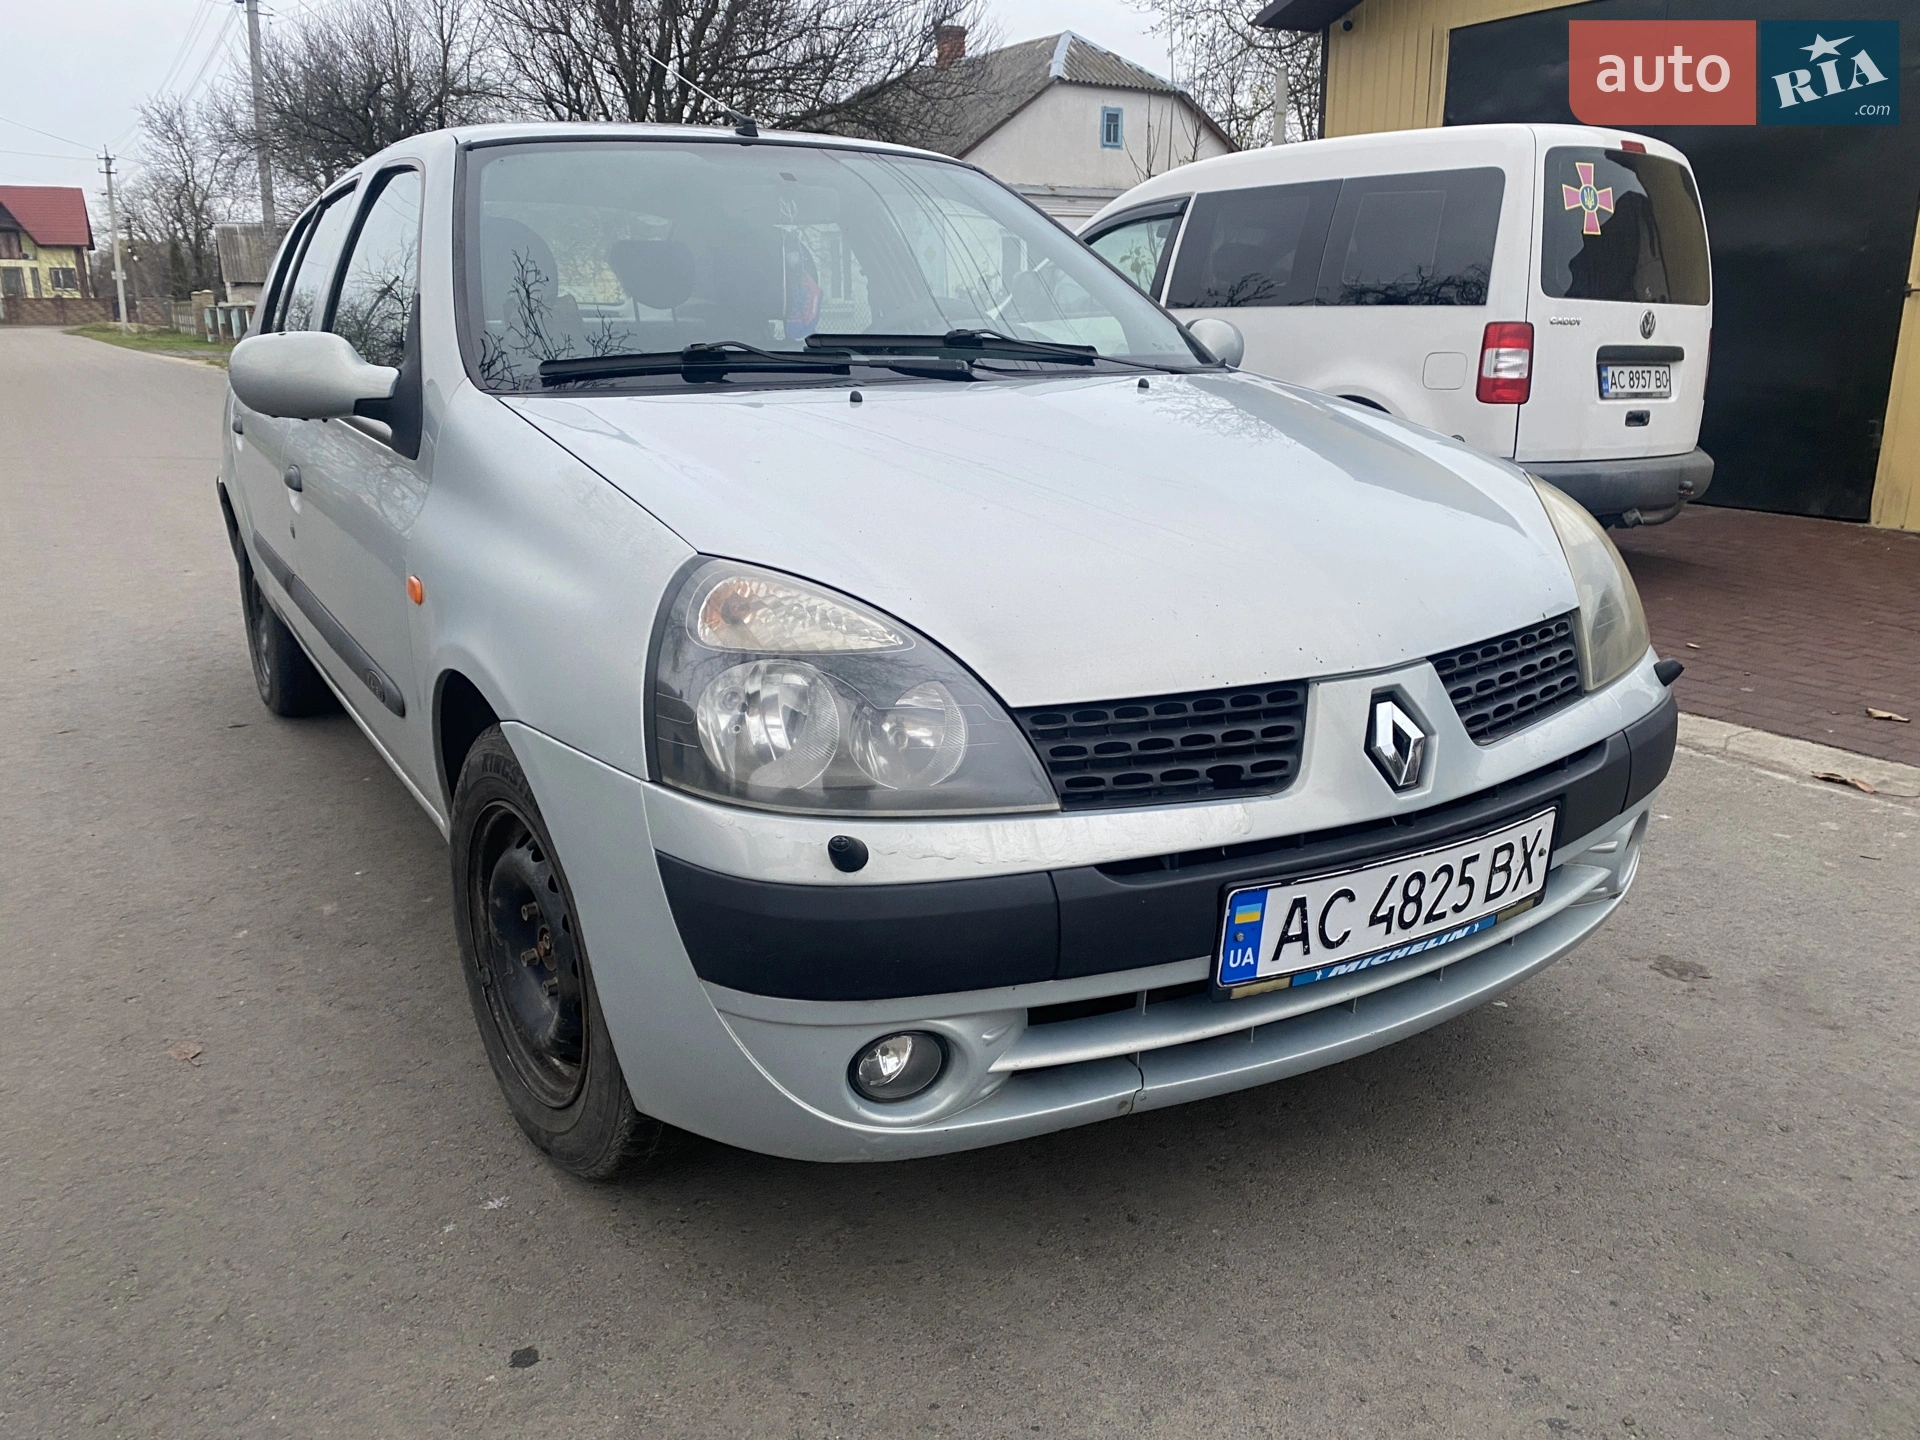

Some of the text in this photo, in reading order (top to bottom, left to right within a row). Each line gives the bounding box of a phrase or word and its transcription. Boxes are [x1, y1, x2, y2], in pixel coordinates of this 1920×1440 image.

[1549, 316, 1582, 326] CADDY
[1610, 368, 1626, 390] AC
[1628, 368, 1652, 389] 8957
[1271, 828, 1544, 962] AC 4825 BX
[1228, 946, 1255, 968] UA
[1328, 925, 1471, 978] MICHELIN
